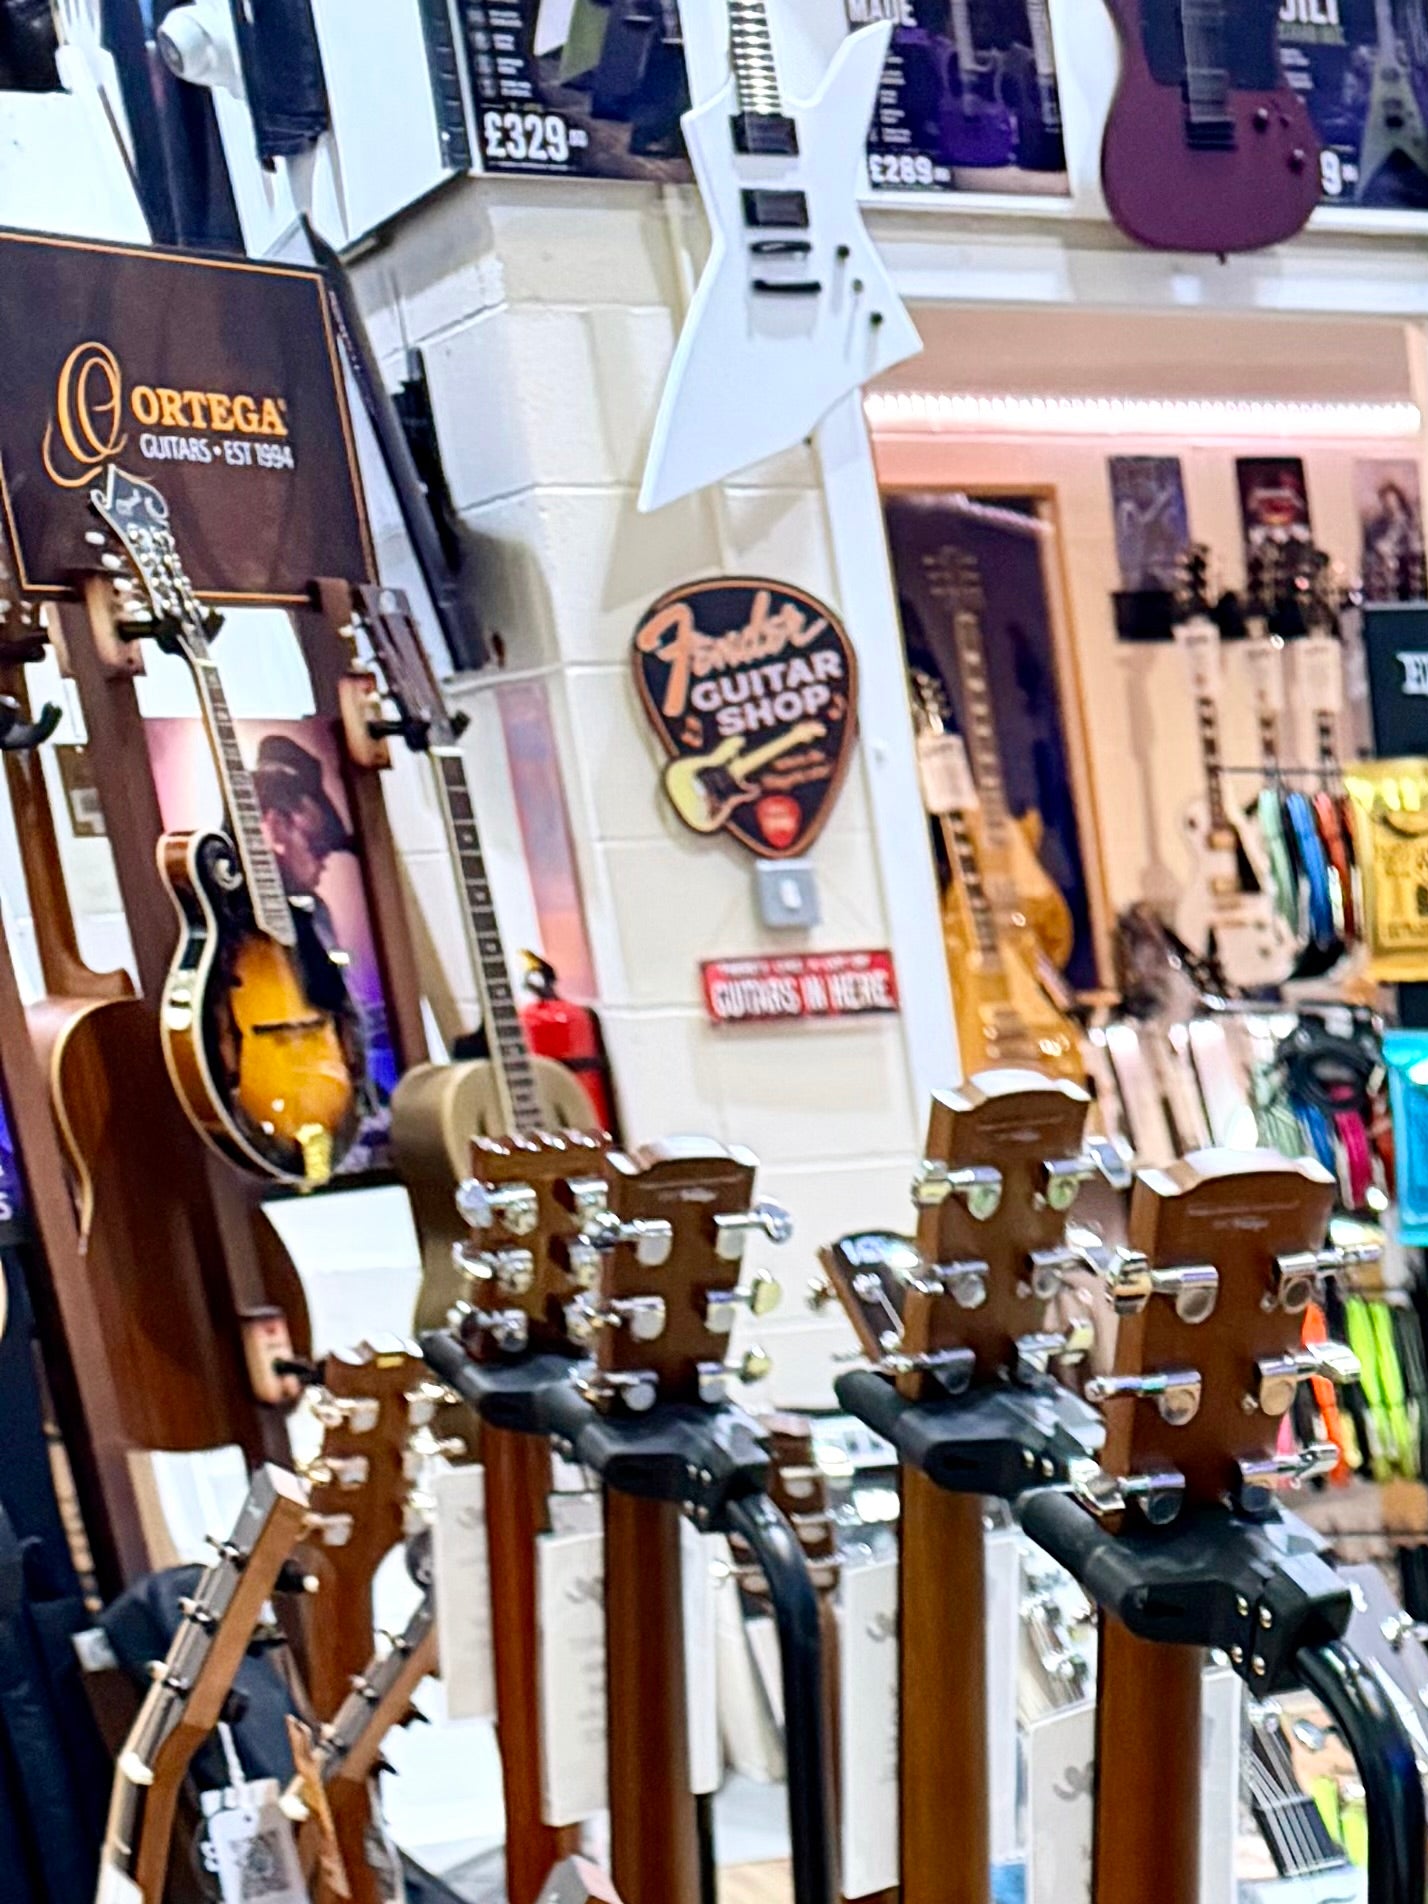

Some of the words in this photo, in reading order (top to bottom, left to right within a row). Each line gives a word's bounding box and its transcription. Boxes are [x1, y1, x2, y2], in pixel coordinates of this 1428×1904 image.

[131, 385, 288, 436] ORTEGA
[139, 432, 213, 464] GUITARS
[222, 440, 251, 466] EST
[255, 442, 295, 469] 1994
[636, 590, 829, 717] Fender
[691, 649, 843, 712] GUITAR
[715, 684, 831, 738] SHOP
